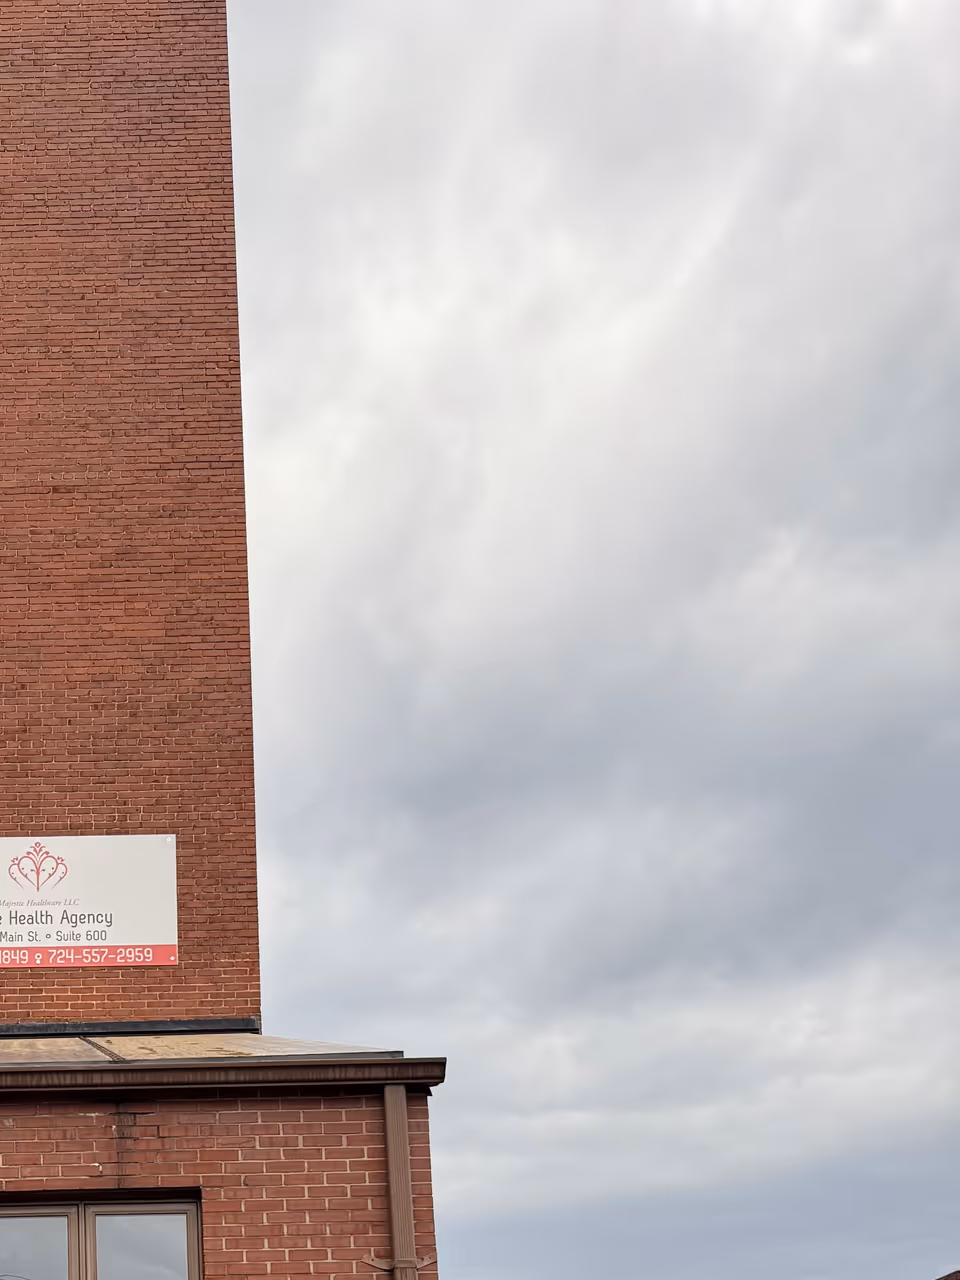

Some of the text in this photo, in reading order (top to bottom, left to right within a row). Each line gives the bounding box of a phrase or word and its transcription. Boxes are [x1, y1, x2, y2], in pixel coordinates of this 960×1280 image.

[26, 899, 62, 907] Healthcare
[9, 910, 53, 925] Health
[60, 909, 113, 928] Agency
[0, 931, 23, 942] Main
[27, 930, 42, 942] St.
[55, 930, 82, 942] Suite
[86, 929, 107, 941] 600
[48, 948, 153, 964] 724-557-2959
